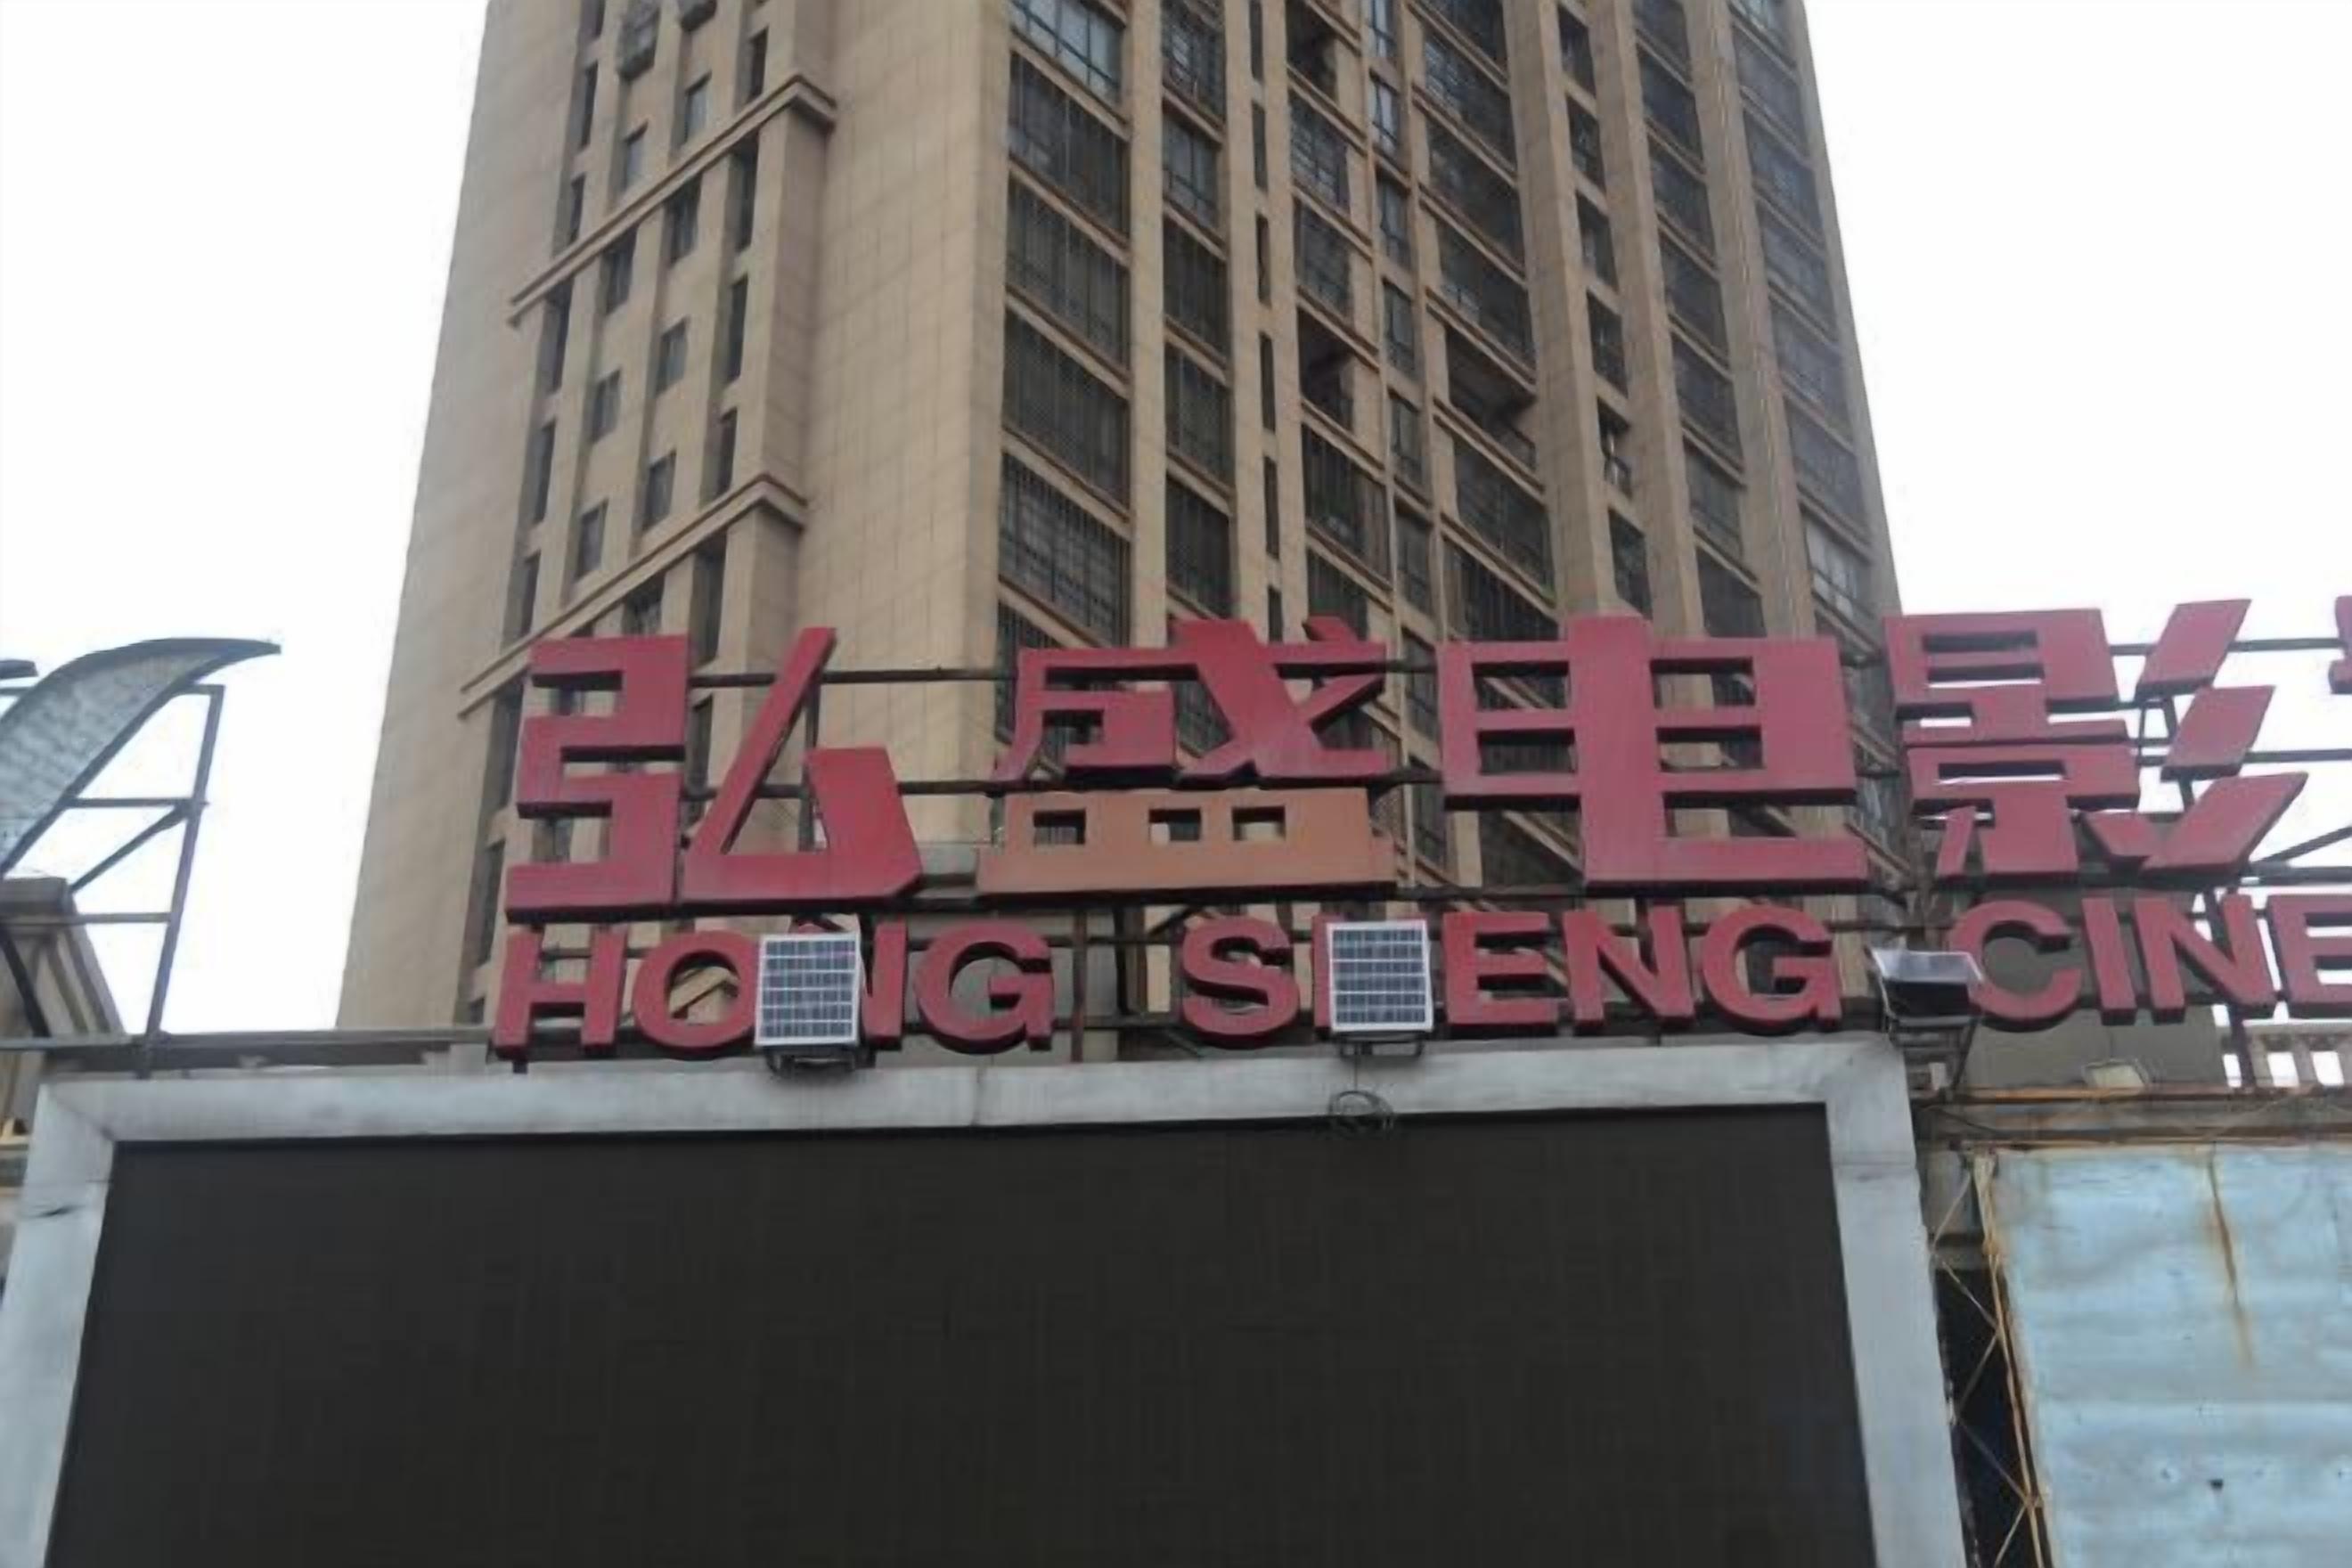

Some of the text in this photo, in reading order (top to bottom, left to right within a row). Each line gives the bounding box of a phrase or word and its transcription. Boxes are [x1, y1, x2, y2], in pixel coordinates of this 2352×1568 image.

[506, 596, 2352, 914] 弘盛电影
[1180, 905, 1842, 1049] SENG
